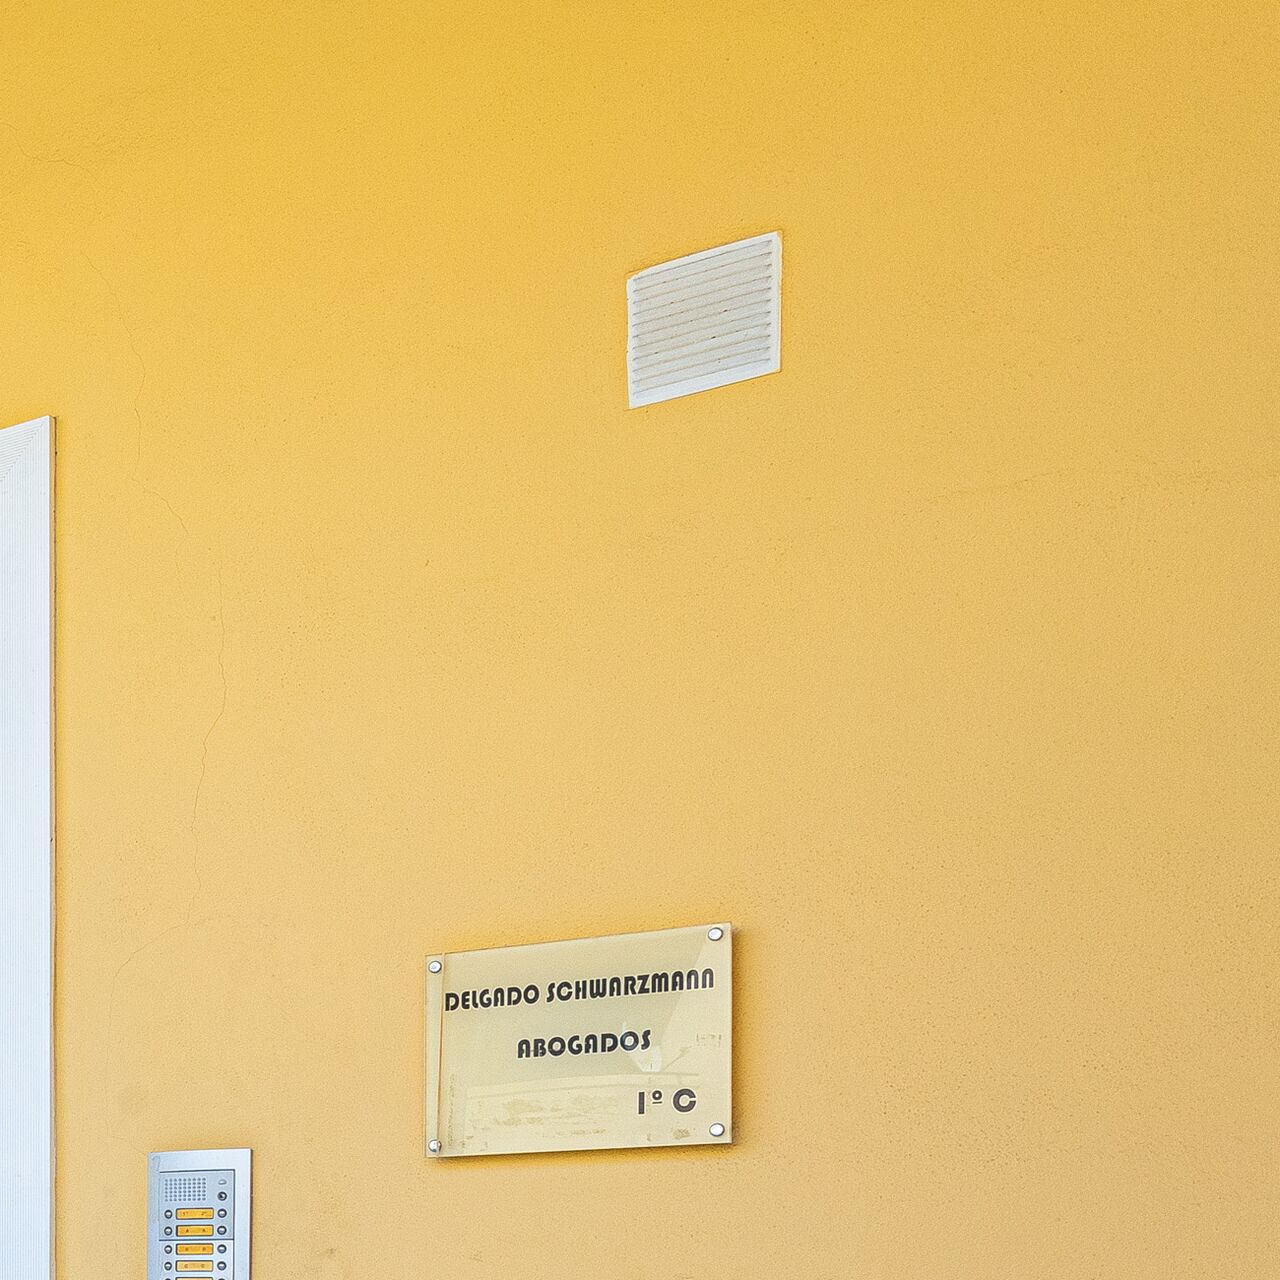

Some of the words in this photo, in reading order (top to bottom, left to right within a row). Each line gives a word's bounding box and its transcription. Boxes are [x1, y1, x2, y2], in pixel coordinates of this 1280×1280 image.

[444, 984, 541, 1012] DELGADO
[546, 967, 715, 1003] SCHWARZMANN
[517, 1029, 652, 1059] ABOGADOS
[672, 1088, 697, 1113] C
